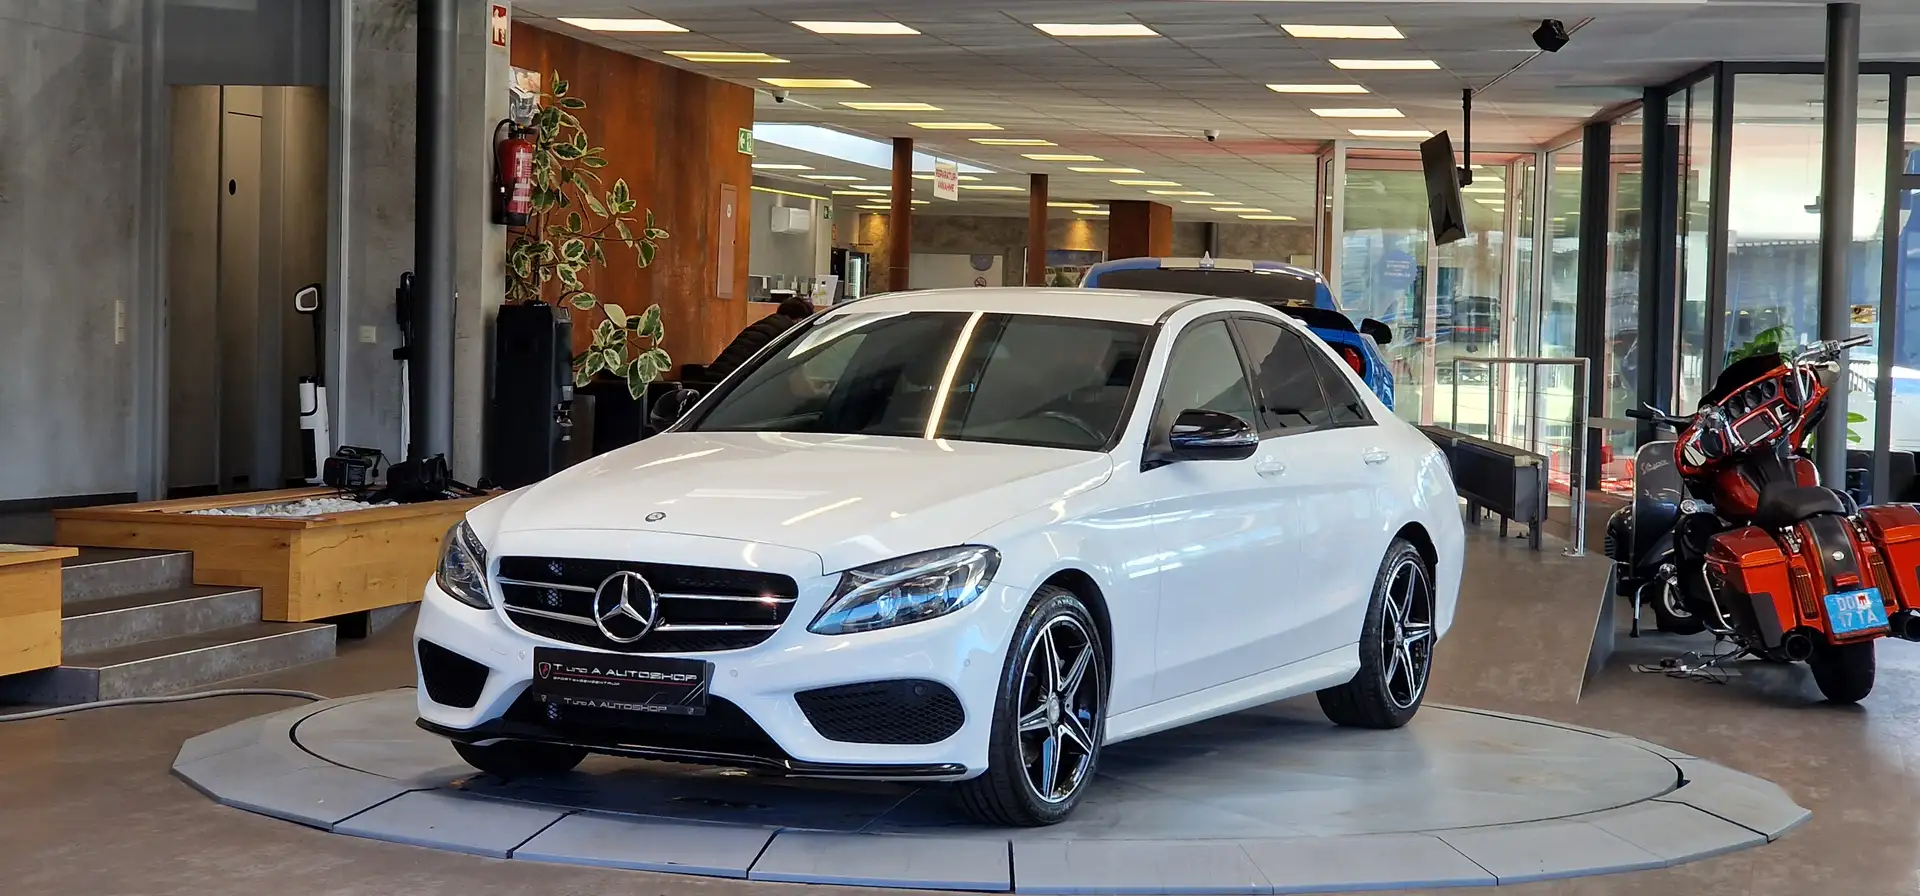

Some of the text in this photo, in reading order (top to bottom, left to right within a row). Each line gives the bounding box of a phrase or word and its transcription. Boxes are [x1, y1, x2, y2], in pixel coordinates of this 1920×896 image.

[553, 663, 563, 671] T
[591, 667, 601, 675] A
[606, 669, 697, 681] AUTOSHOP
[599, 702, 667, 712] AUTOSHOP
